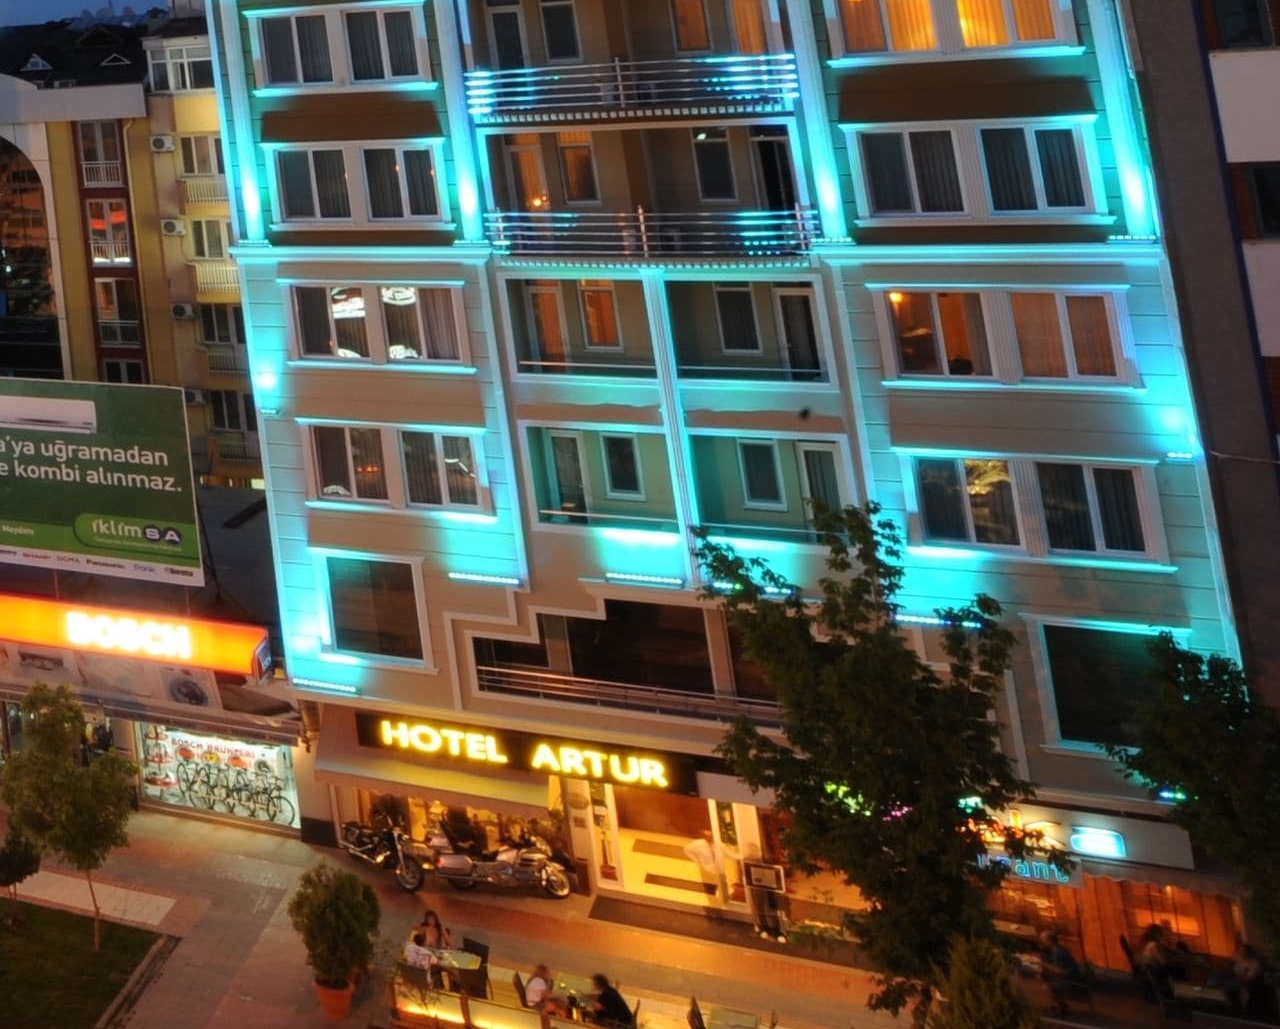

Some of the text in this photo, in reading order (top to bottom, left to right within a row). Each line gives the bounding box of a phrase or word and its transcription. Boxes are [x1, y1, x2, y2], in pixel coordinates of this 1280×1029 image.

[40, 440, 168, 467] uğramadan
[14, 460, 80, 483] kombi
[86, 467, 183, 492] alınmaz.
[68, 613, 191, 658] BOSCH
[380, 720, 669, 788] HOTEL ARTUR
